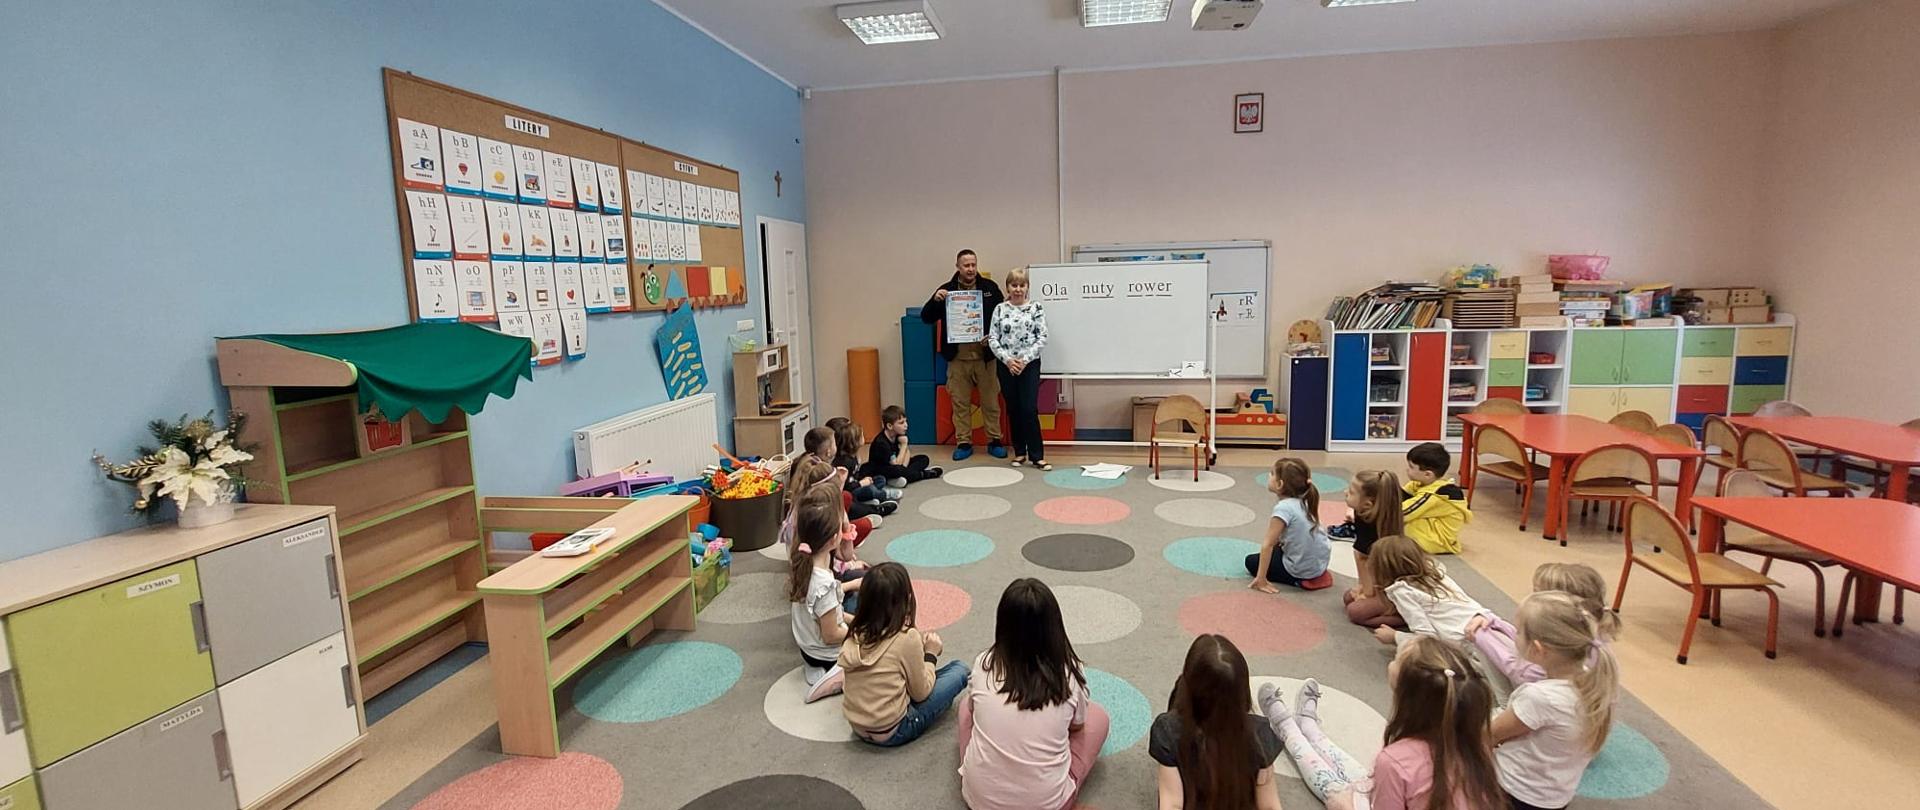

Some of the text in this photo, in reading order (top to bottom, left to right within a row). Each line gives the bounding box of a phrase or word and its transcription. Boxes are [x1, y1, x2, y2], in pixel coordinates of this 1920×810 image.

[512, 118, 543, 136] LITERY
[1042, 280, 1173, 297] Ola nuty rower
[1239, 296, 1254, 306] rR
[285, 528, 324, 545] ALEKSANDER
[138, 578, 174, 592] SZYMON
[162, 707, 202, 729] MATYLDA
